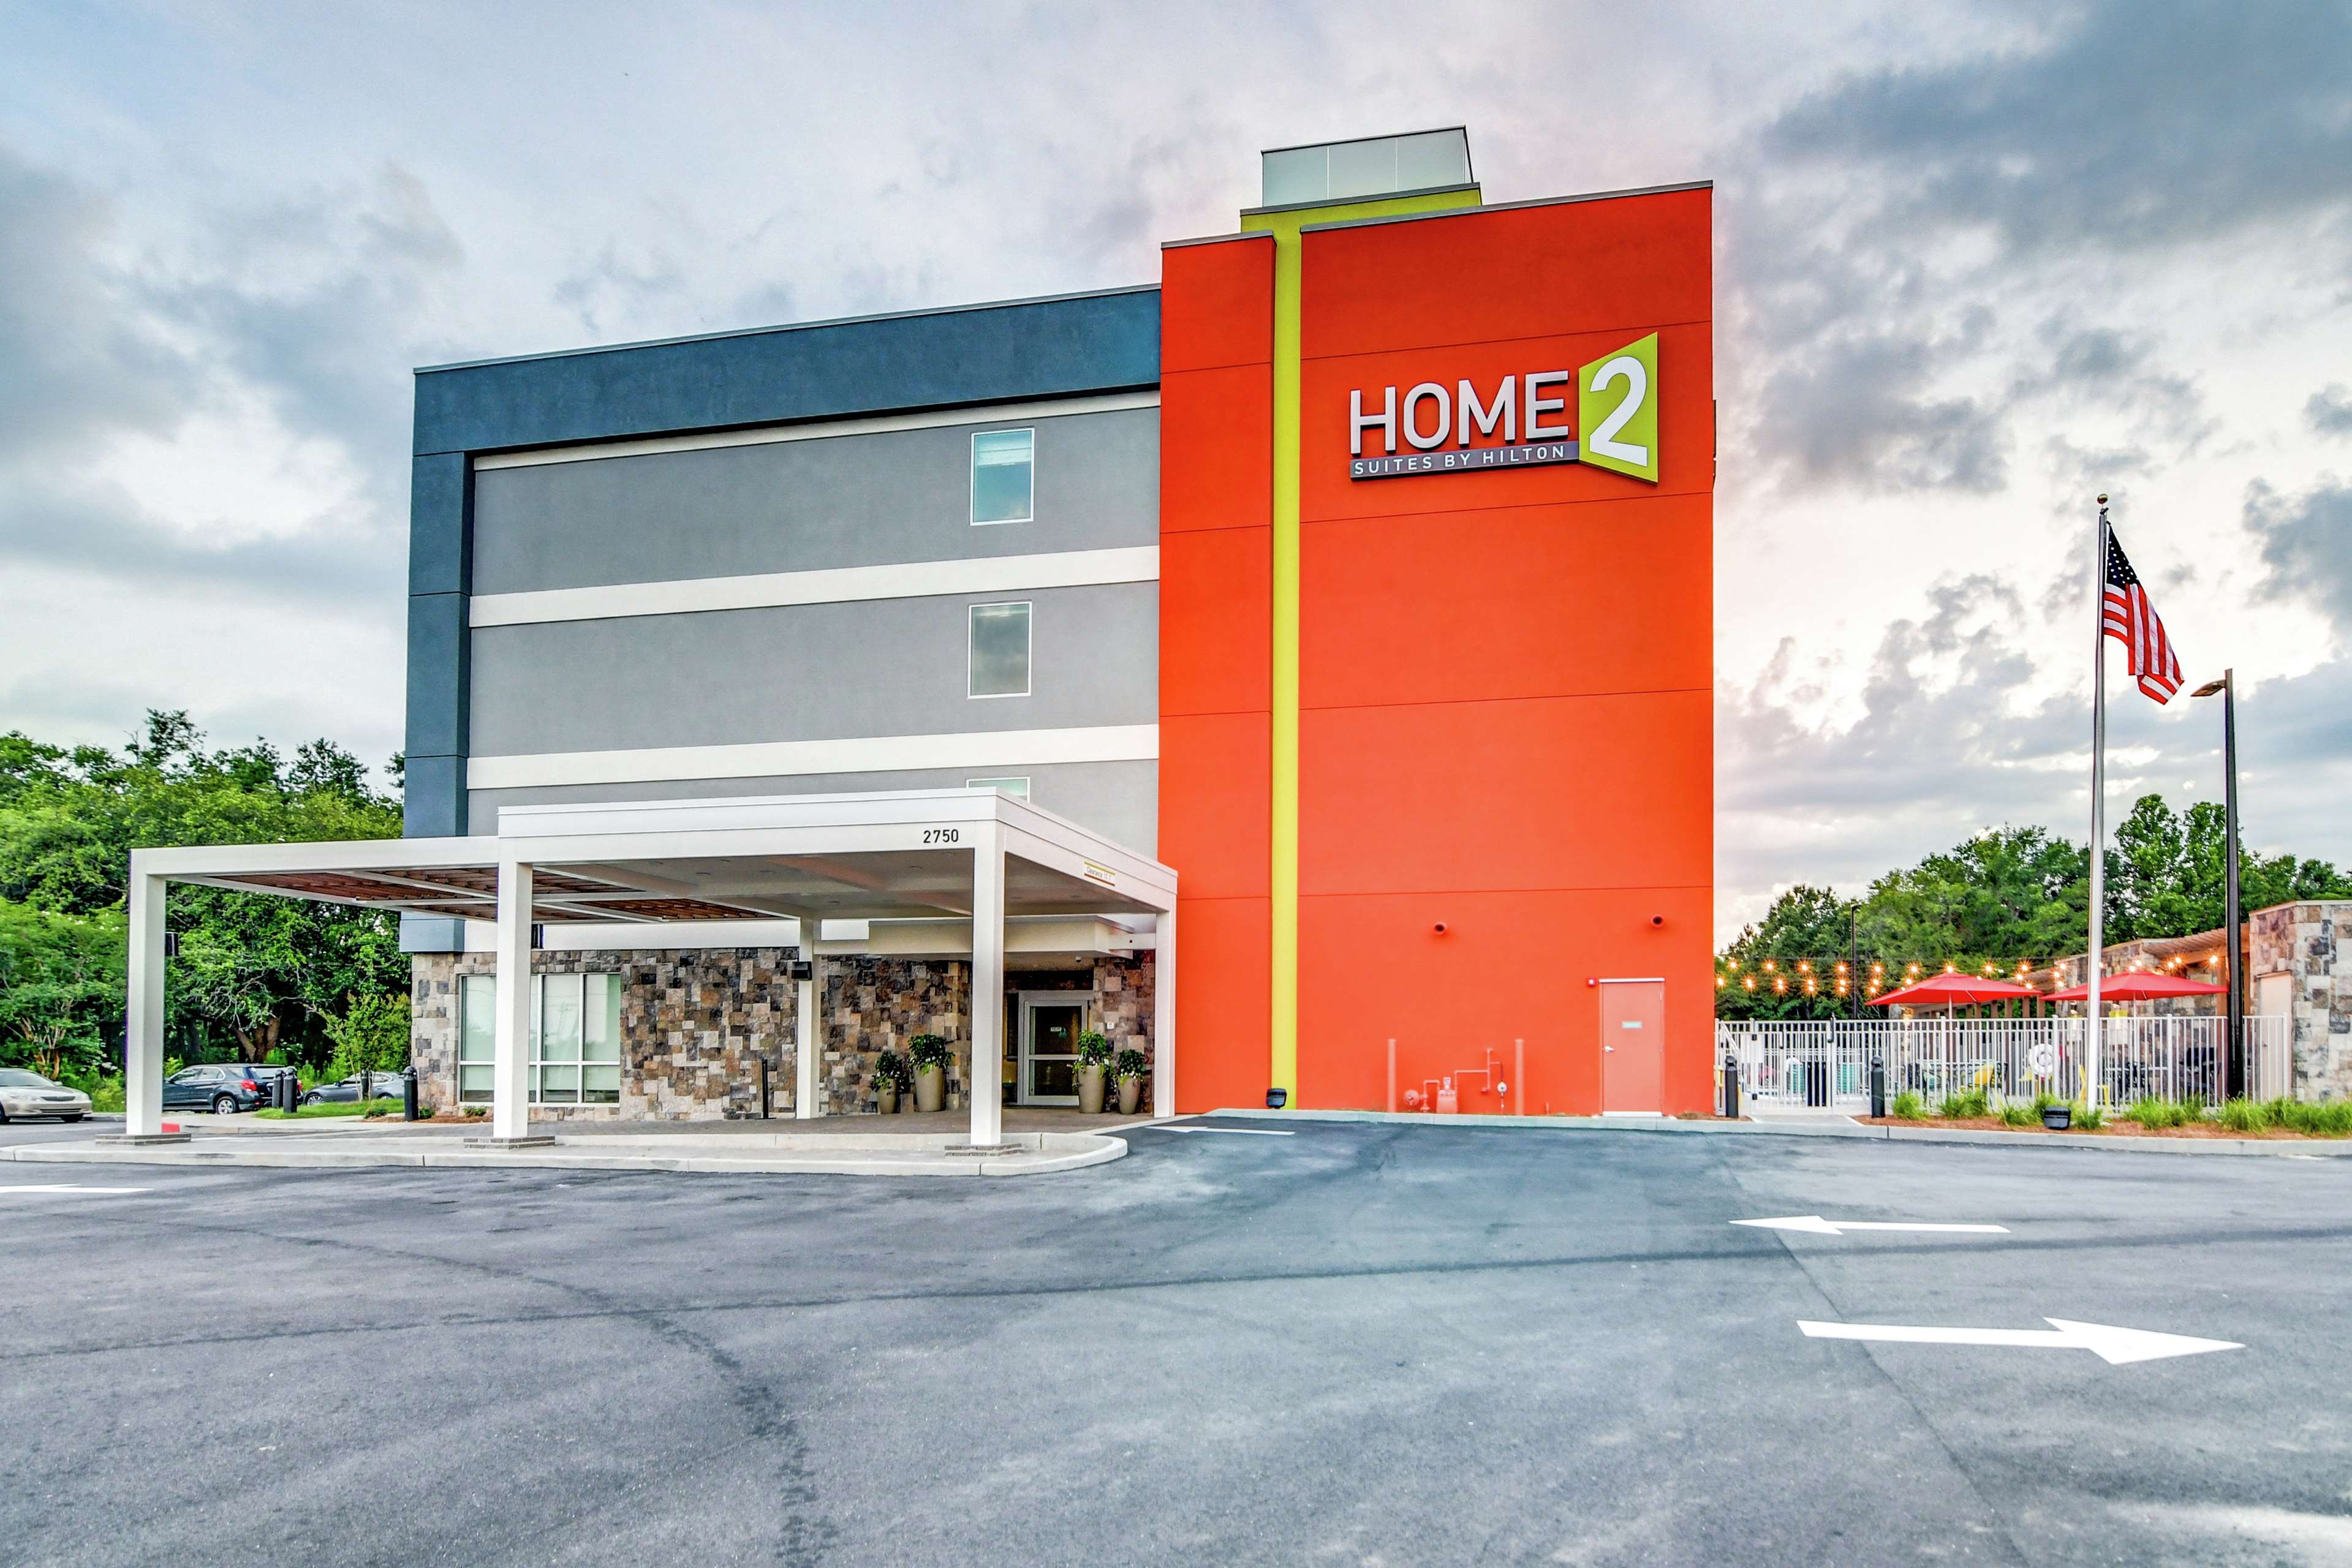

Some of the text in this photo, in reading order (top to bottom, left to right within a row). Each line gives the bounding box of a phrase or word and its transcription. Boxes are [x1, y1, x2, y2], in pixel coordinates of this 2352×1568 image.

[1350, 355, 1648, 467] HOME 2
[1354, 445, 1564, 475] SUITES BY HILTON
[923, 829, 959, 843] 2750
